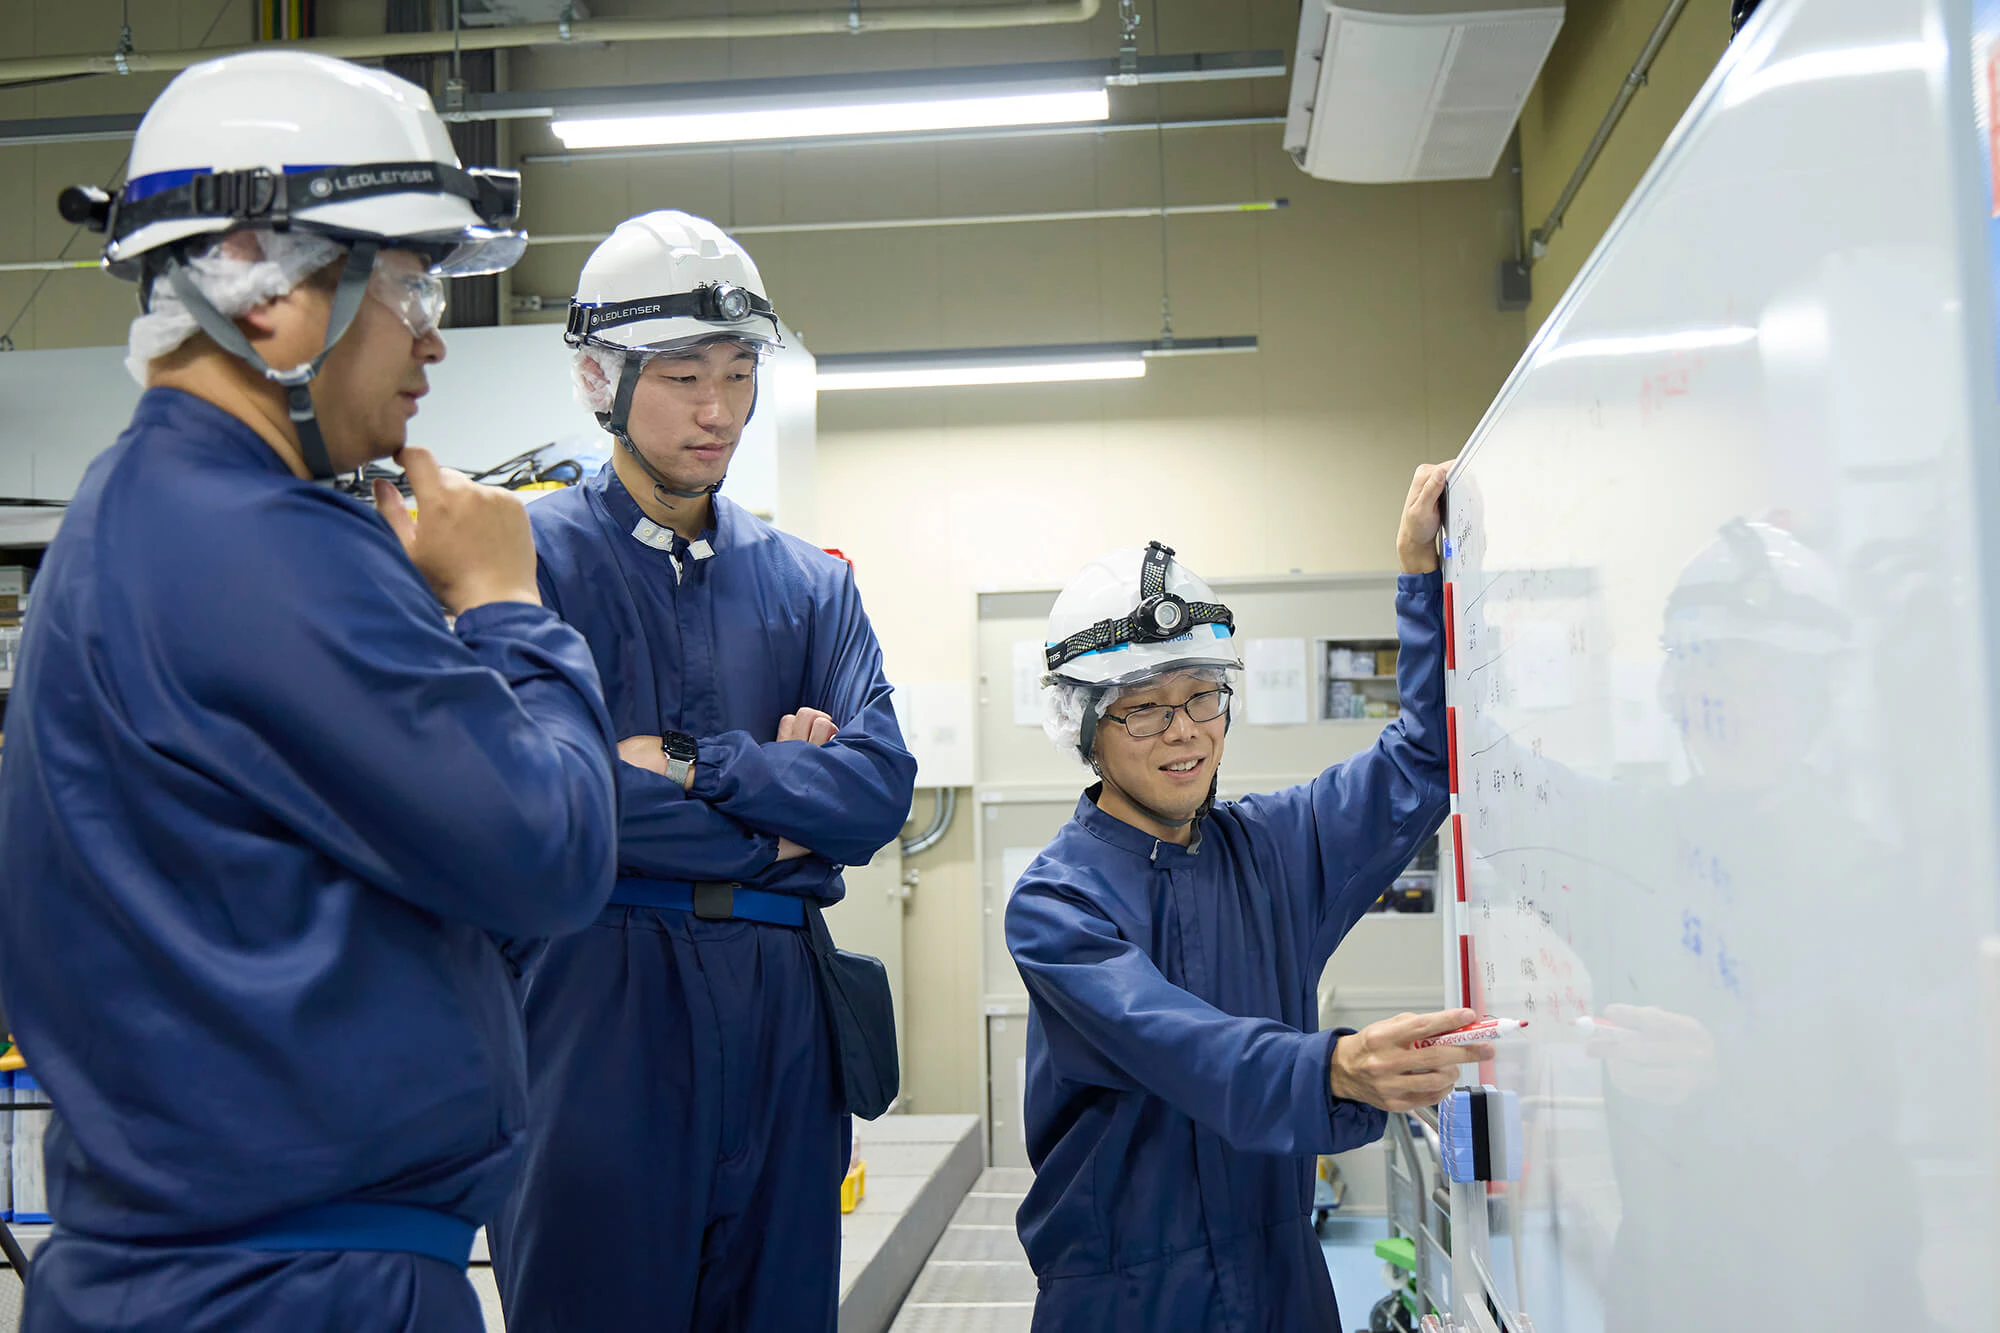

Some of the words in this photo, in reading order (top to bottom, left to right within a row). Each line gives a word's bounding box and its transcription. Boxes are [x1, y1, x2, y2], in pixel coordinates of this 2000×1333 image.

[335, 170, 433, 190] LEDLENSER
[601, 304, 660, 321] LEDLENSER
[1467, 1027, 1497, 1040] BOARD
